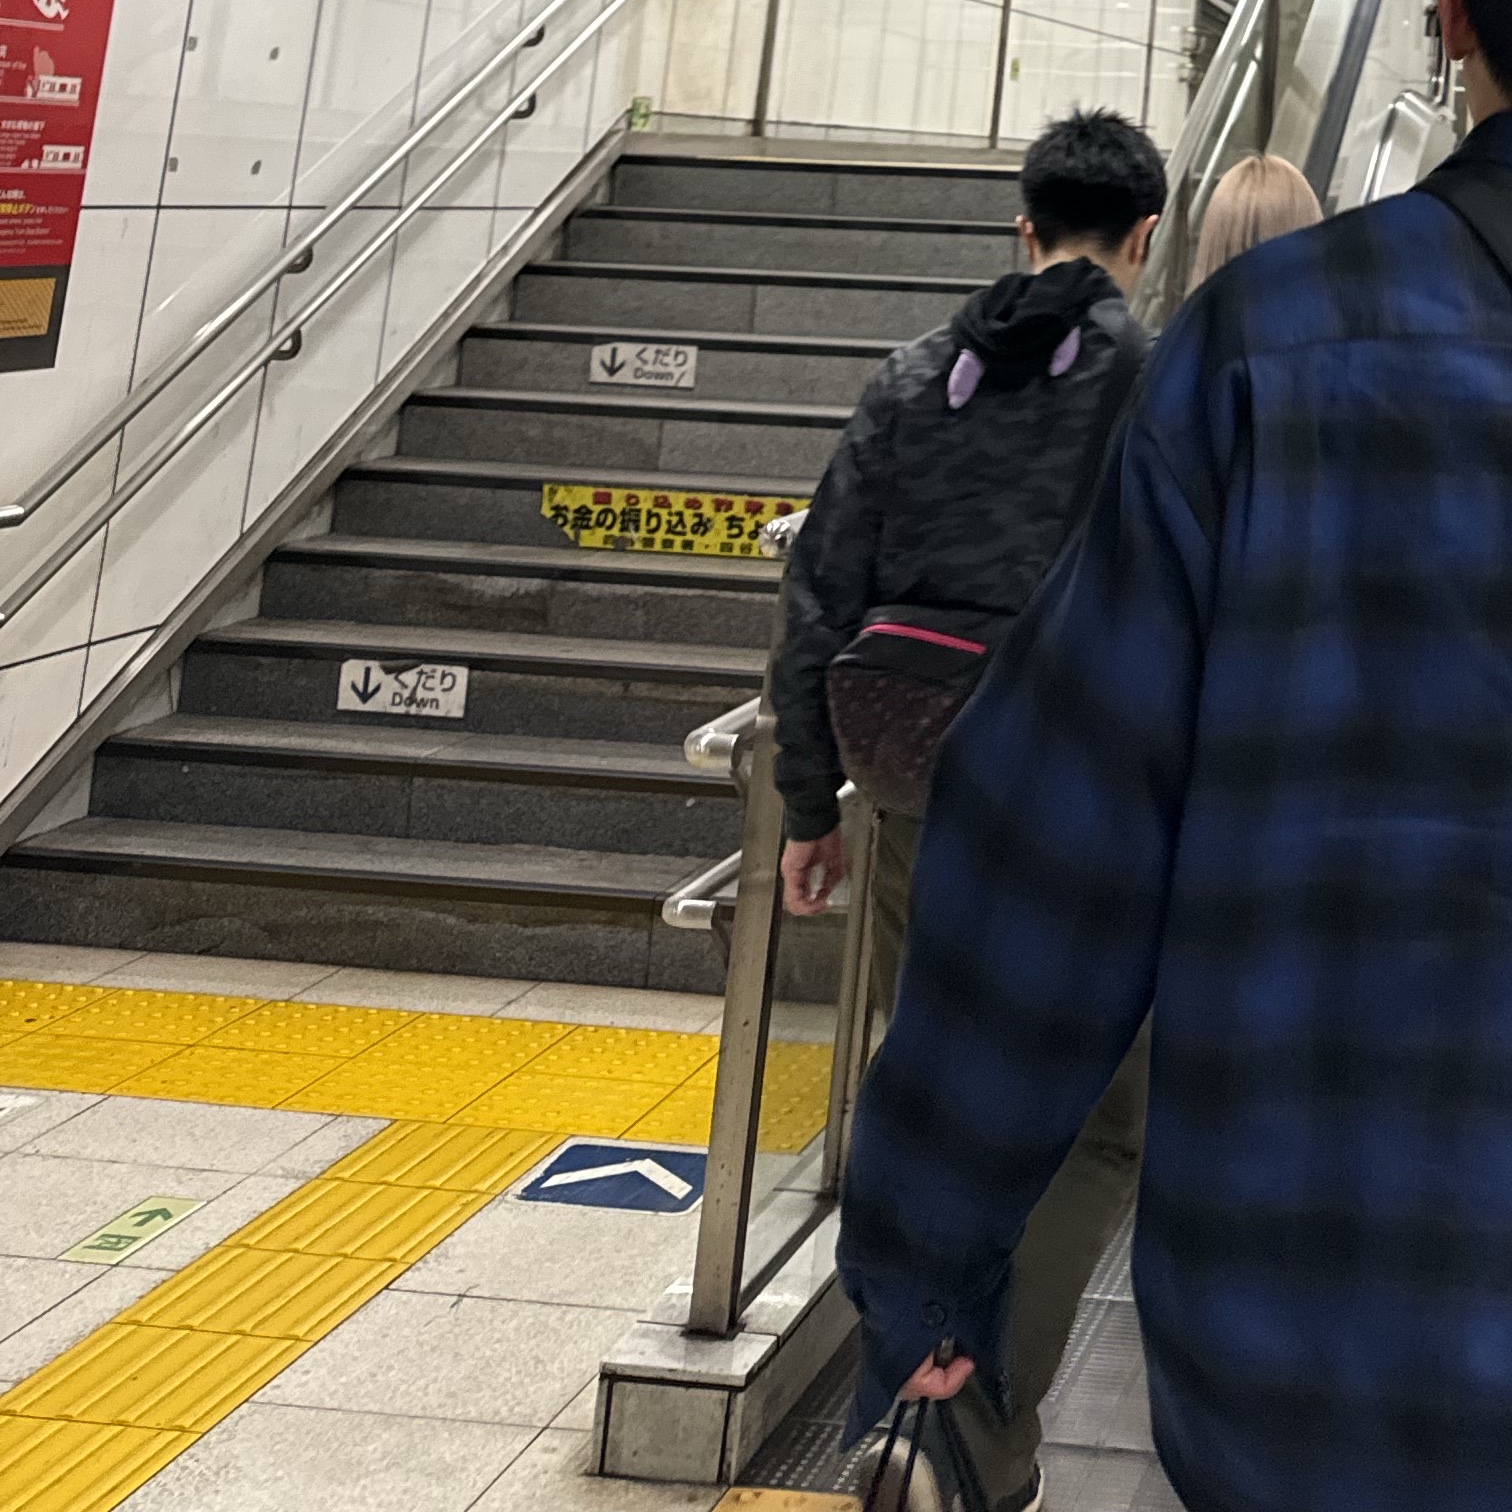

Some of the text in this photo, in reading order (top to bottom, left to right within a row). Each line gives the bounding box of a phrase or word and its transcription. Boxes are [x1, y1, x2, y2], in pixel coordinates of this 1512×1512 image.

[635, 347, 687, 368] くだり
[633, 367, 674, 381] Down
[391, 691, 440, 710] Down
